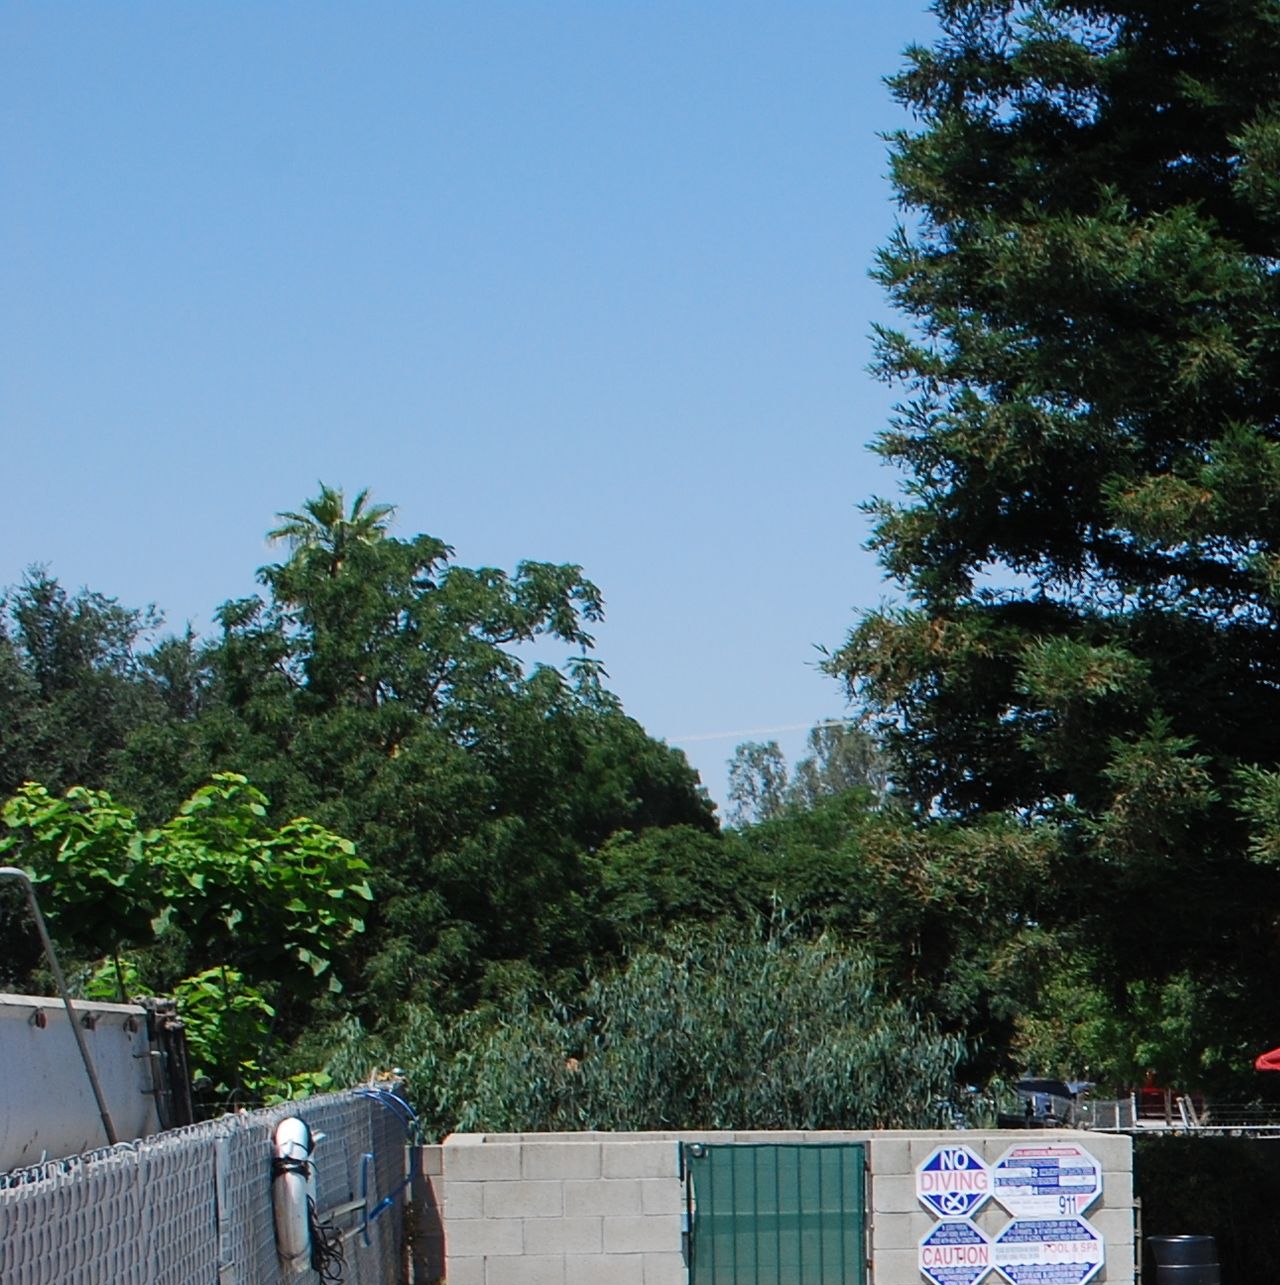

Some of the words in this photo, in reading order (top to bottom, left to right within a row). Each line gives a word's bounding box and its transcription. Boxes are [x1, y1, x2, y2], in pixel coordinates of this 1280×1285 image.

[941, 1150, 968, 1170] NO
[921, 1172, 988, 1191] DIVING
[1059, 1195, 1076, 1214] 911
[922, 1247, 989, 1265] CAUTION
[1081, 1242, 1098, 1251] SPA
